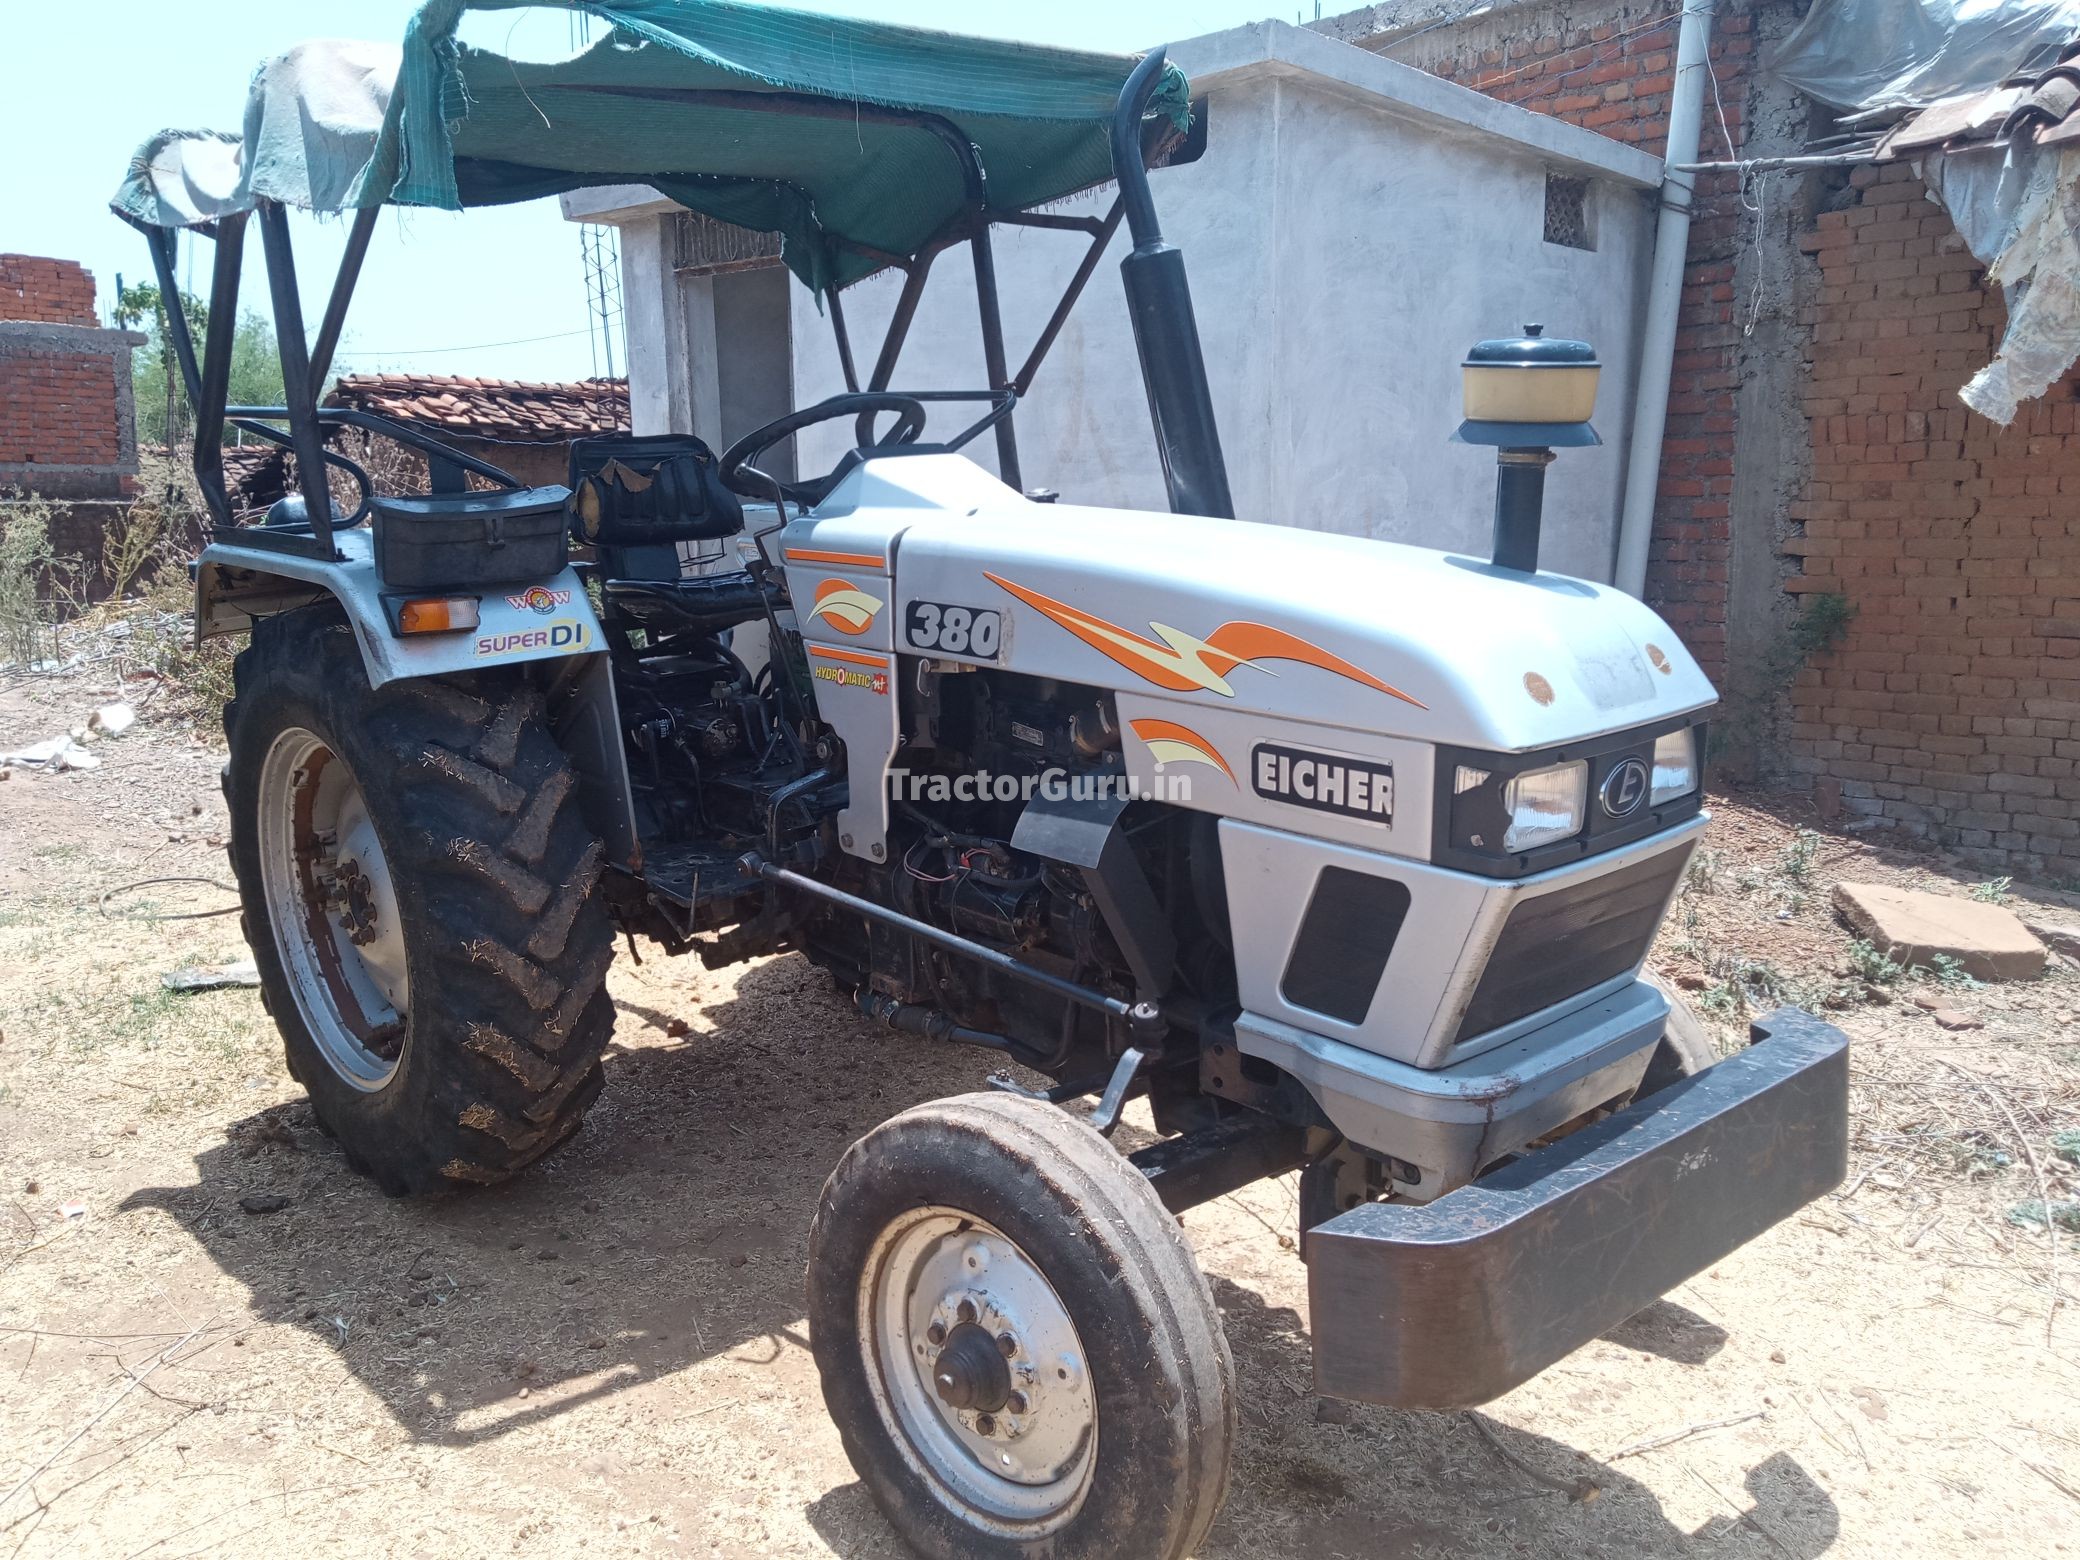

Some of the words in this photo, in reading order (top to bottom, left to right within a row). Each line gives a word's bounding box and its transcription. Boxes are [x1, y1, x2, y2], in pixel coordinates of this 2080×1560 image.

[506, 587, 570, 613] WOW
[478, 632, 548, 655] SUPER
[550, 623, 582, 647] DI
[911, 603, 1000, 657] 380
[815, 666, 871, 688] HYDROMATIC
[1258, 751, 1393, 815] EICHER
